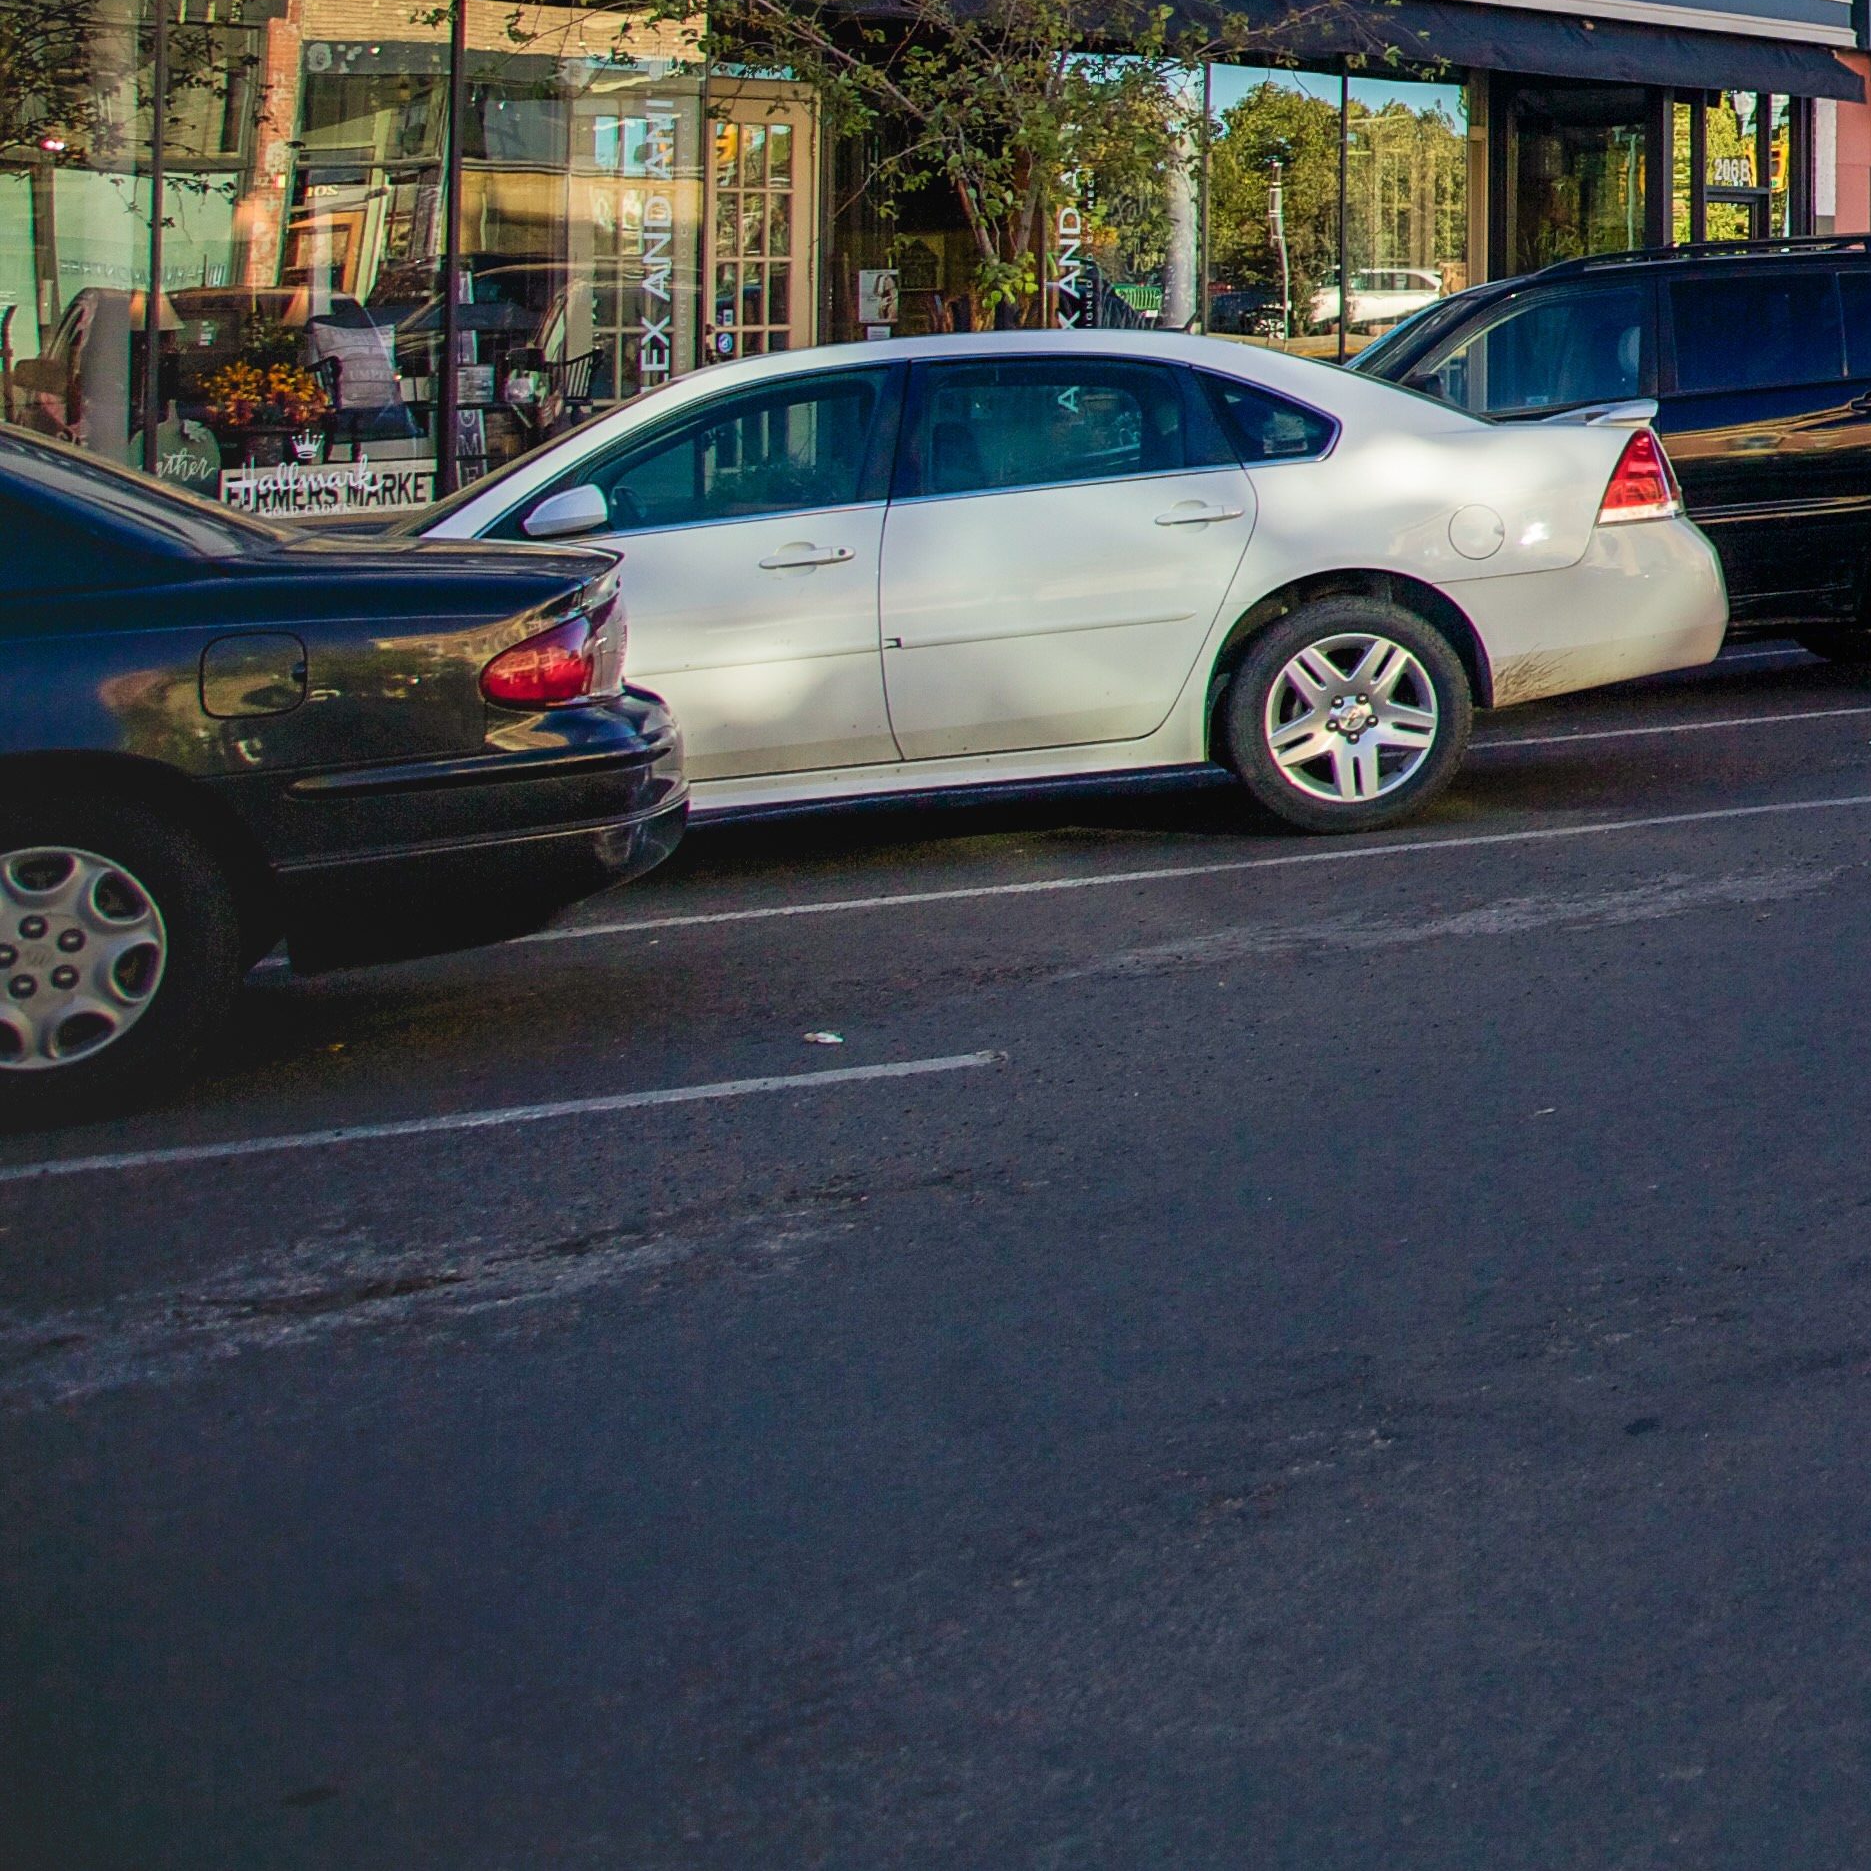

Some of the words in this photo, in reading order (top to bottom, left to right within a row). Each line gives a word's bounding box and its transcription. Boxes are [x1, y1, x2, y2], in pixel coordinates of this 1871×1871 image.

[645, 99, 675, 180] ANI
[1714, 159, 1739, 181] 206
[641, 196, 673, 302] AND
[1058, 207, 1082, 298] AND
[225, 454, 386, 510] Hallmark
[264, 507, 299, 517] GOLD
[304, 503, 352, 515] CROWN
